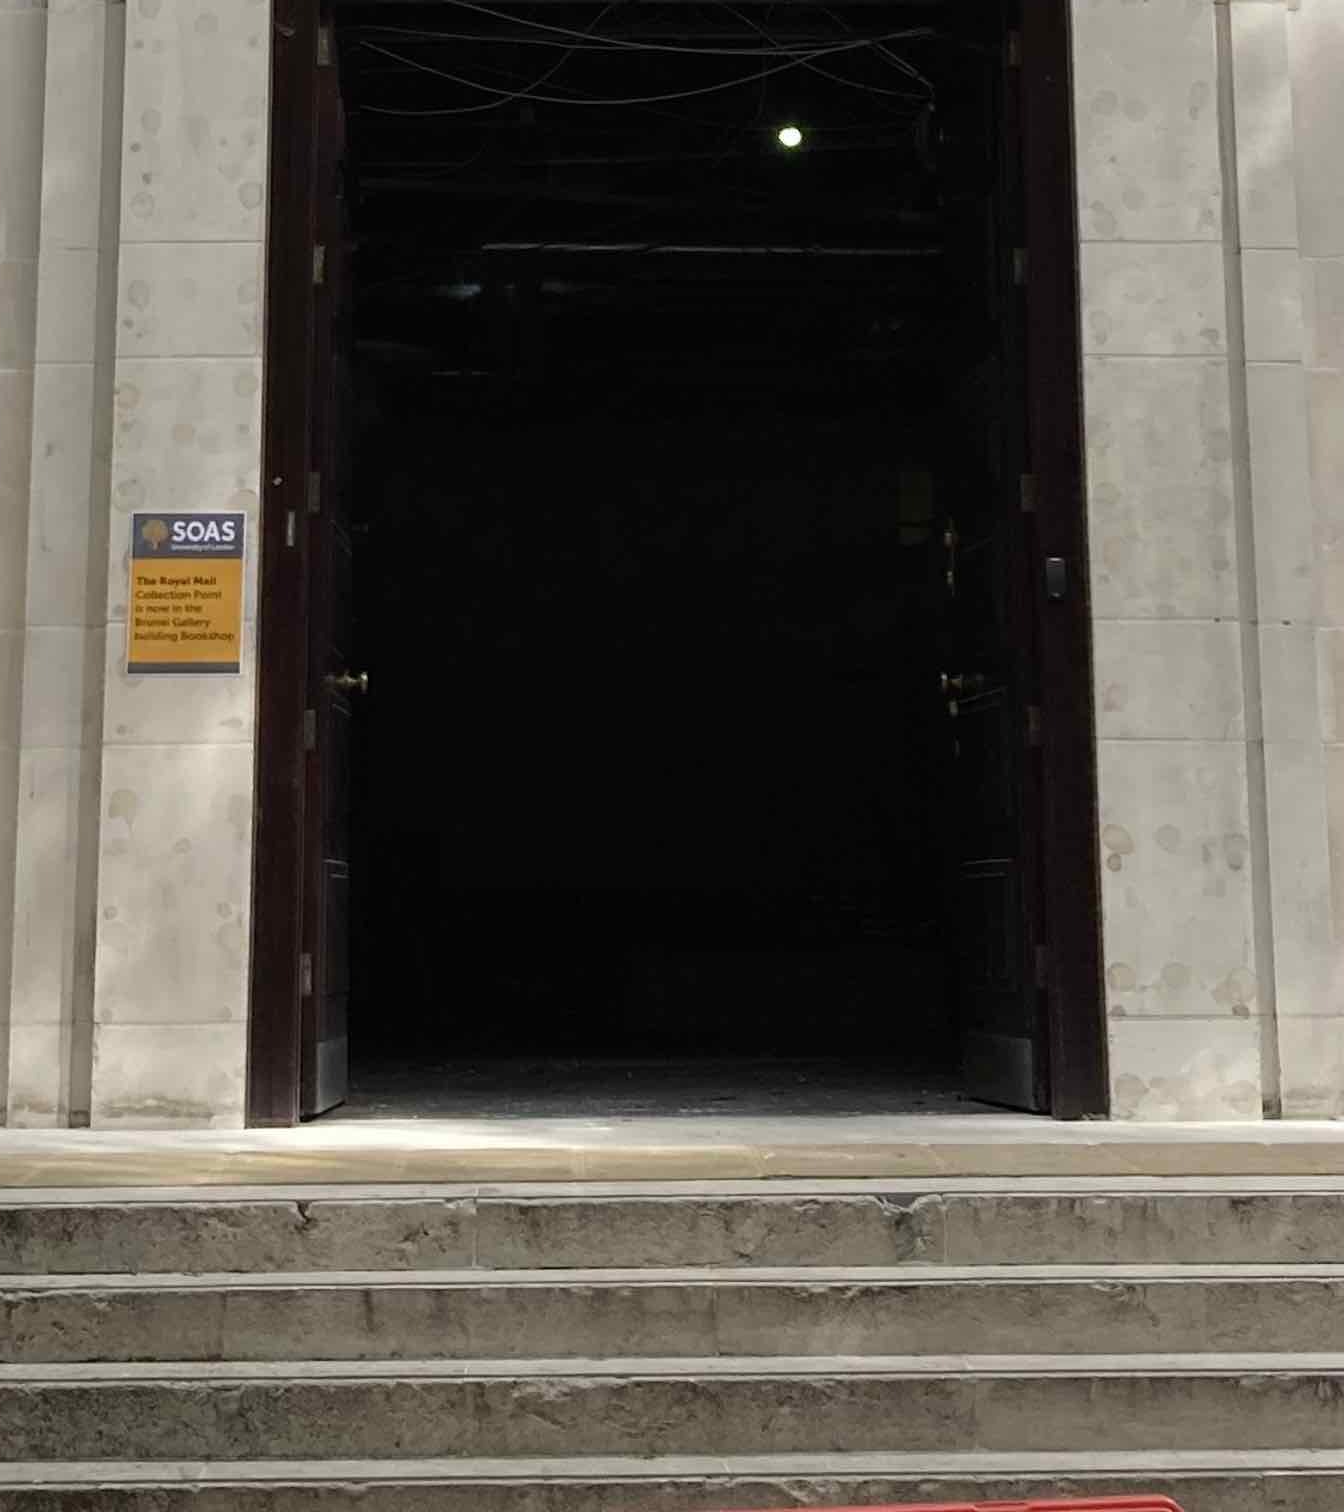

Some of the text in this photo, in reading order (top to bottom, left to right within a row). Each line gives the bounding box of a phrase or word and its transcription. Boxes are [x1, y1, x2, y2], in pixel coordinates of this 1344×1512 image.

[171, 520, 236, 543] SOAS
[136, 575, 217, 589] The Royal Mail
[135, 590, 222, 600] Collection Point
[185, 604, 203, 613] the
